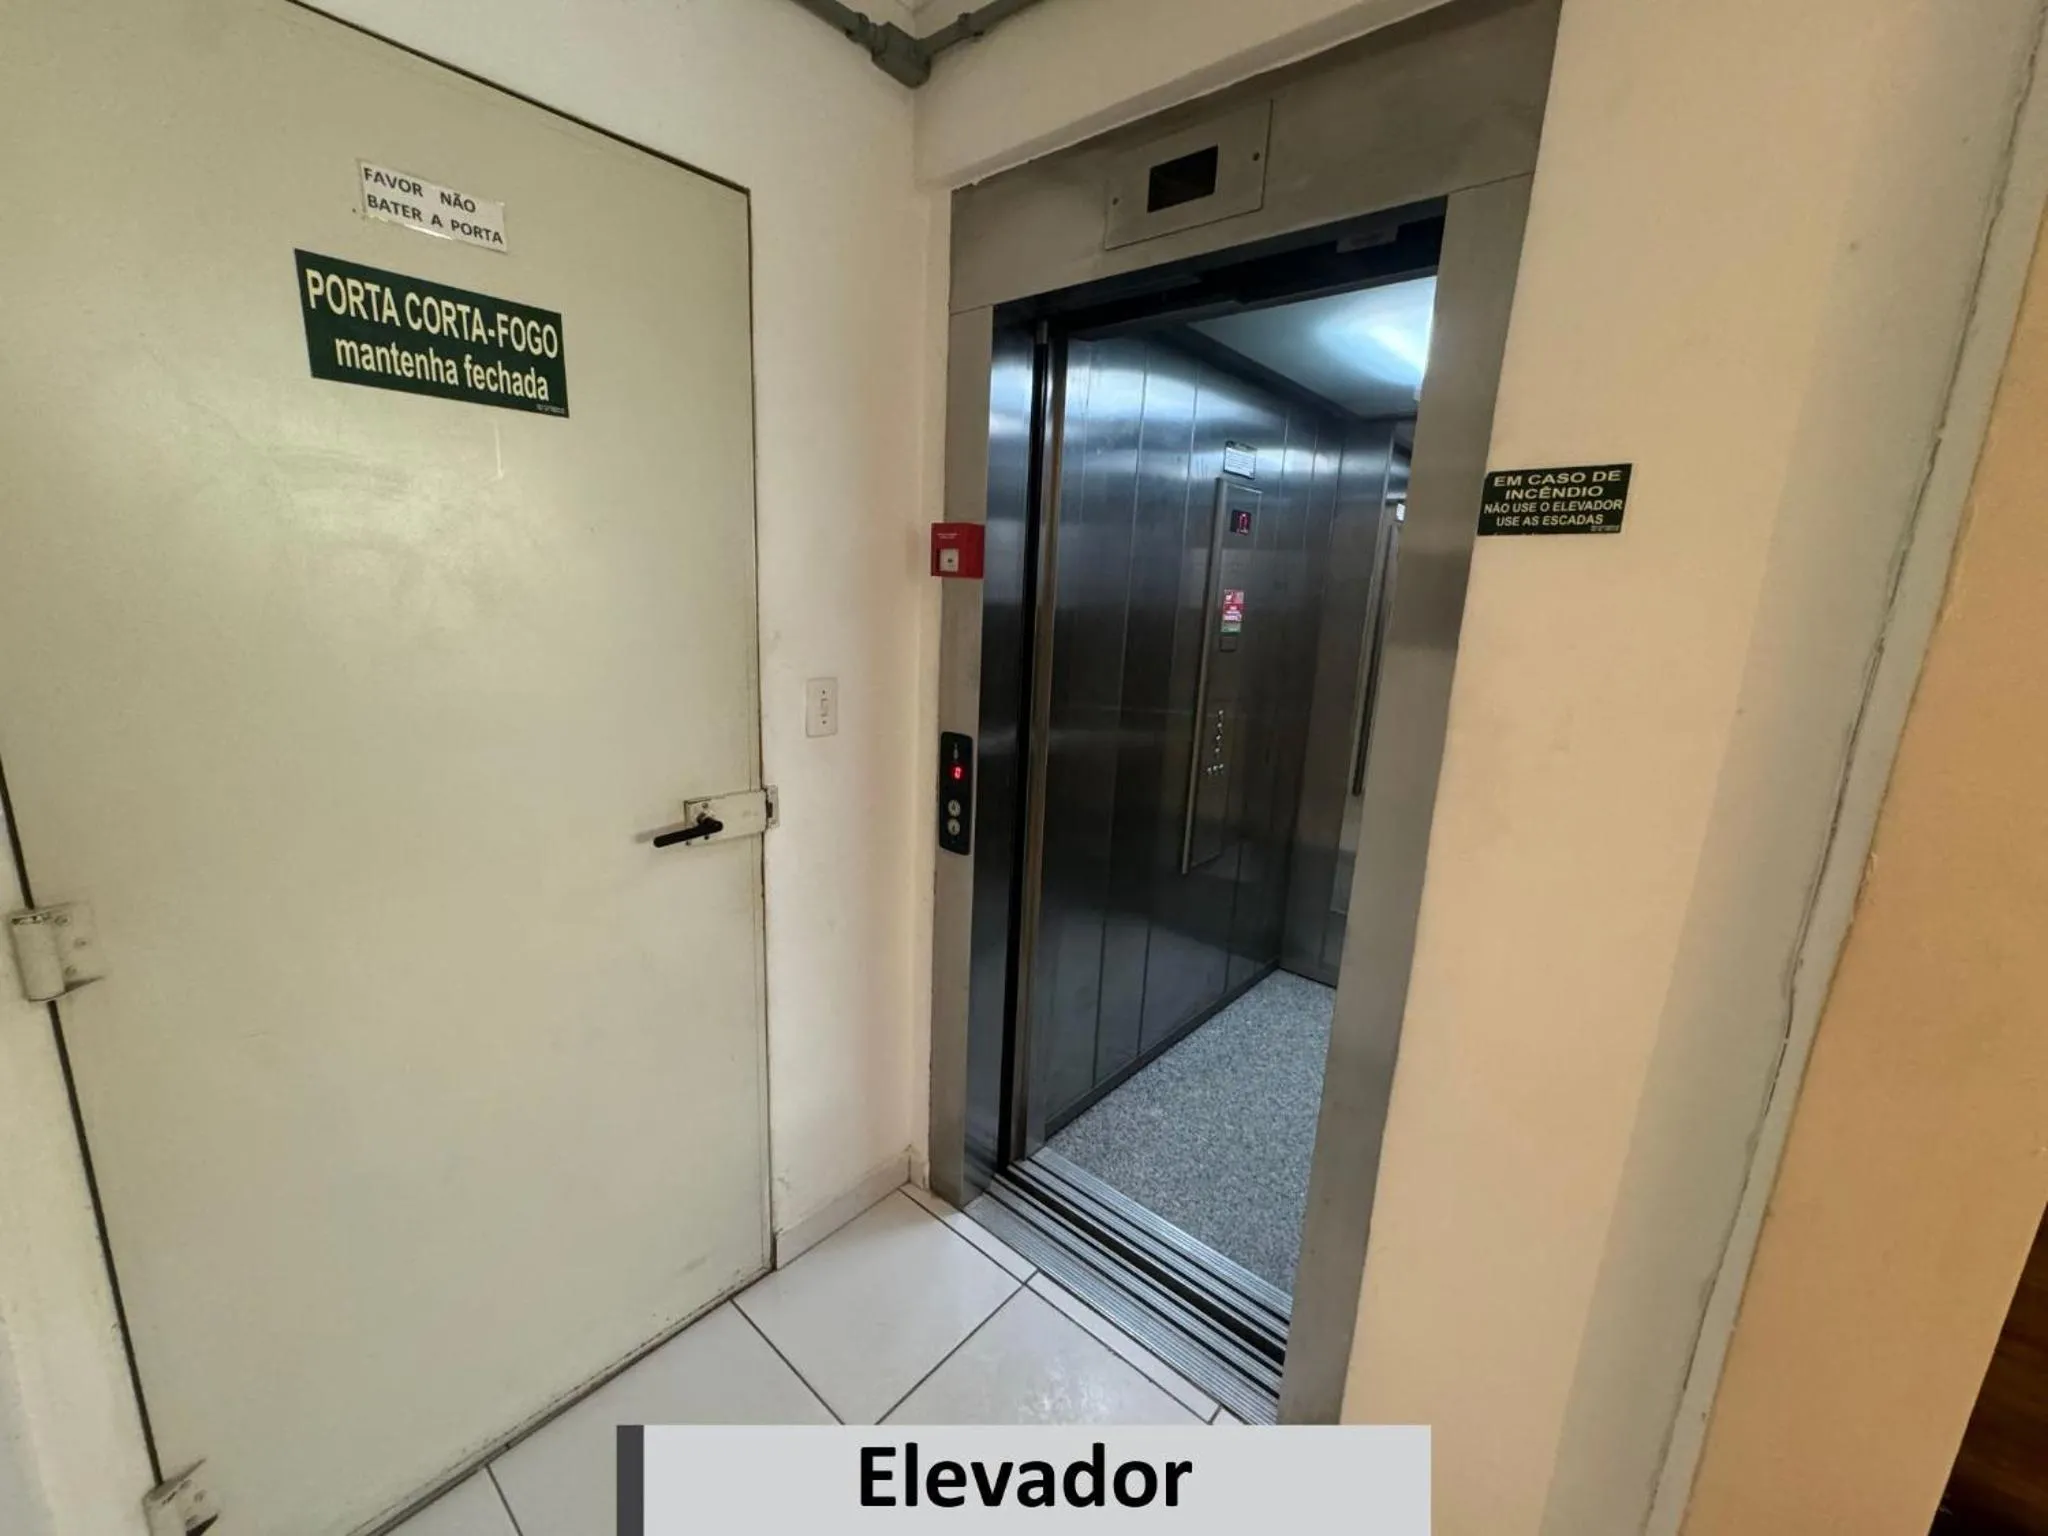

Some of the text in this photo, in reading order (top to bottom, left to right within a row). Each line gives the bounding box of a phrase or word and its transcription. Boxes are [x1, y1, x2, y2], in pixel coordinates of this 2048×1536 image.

[363, 167, 476, 214] FAVOR NÃO
[366, 193, 503, 245] BATER A PORTA
[306, 268, 558, 358] PORTA CORTA-FOGO
[335, 336, 549, 400] mantenha fechada
[1494, 470, 1621, 487] EM CASO DE
[1505, 485, 1603, 500] INCÊNDIO
[1484, 499, 1623, 514] NÃO USE O ELEVADOR
[1496, 514, 1604, 526] USE AS ESCADAS
